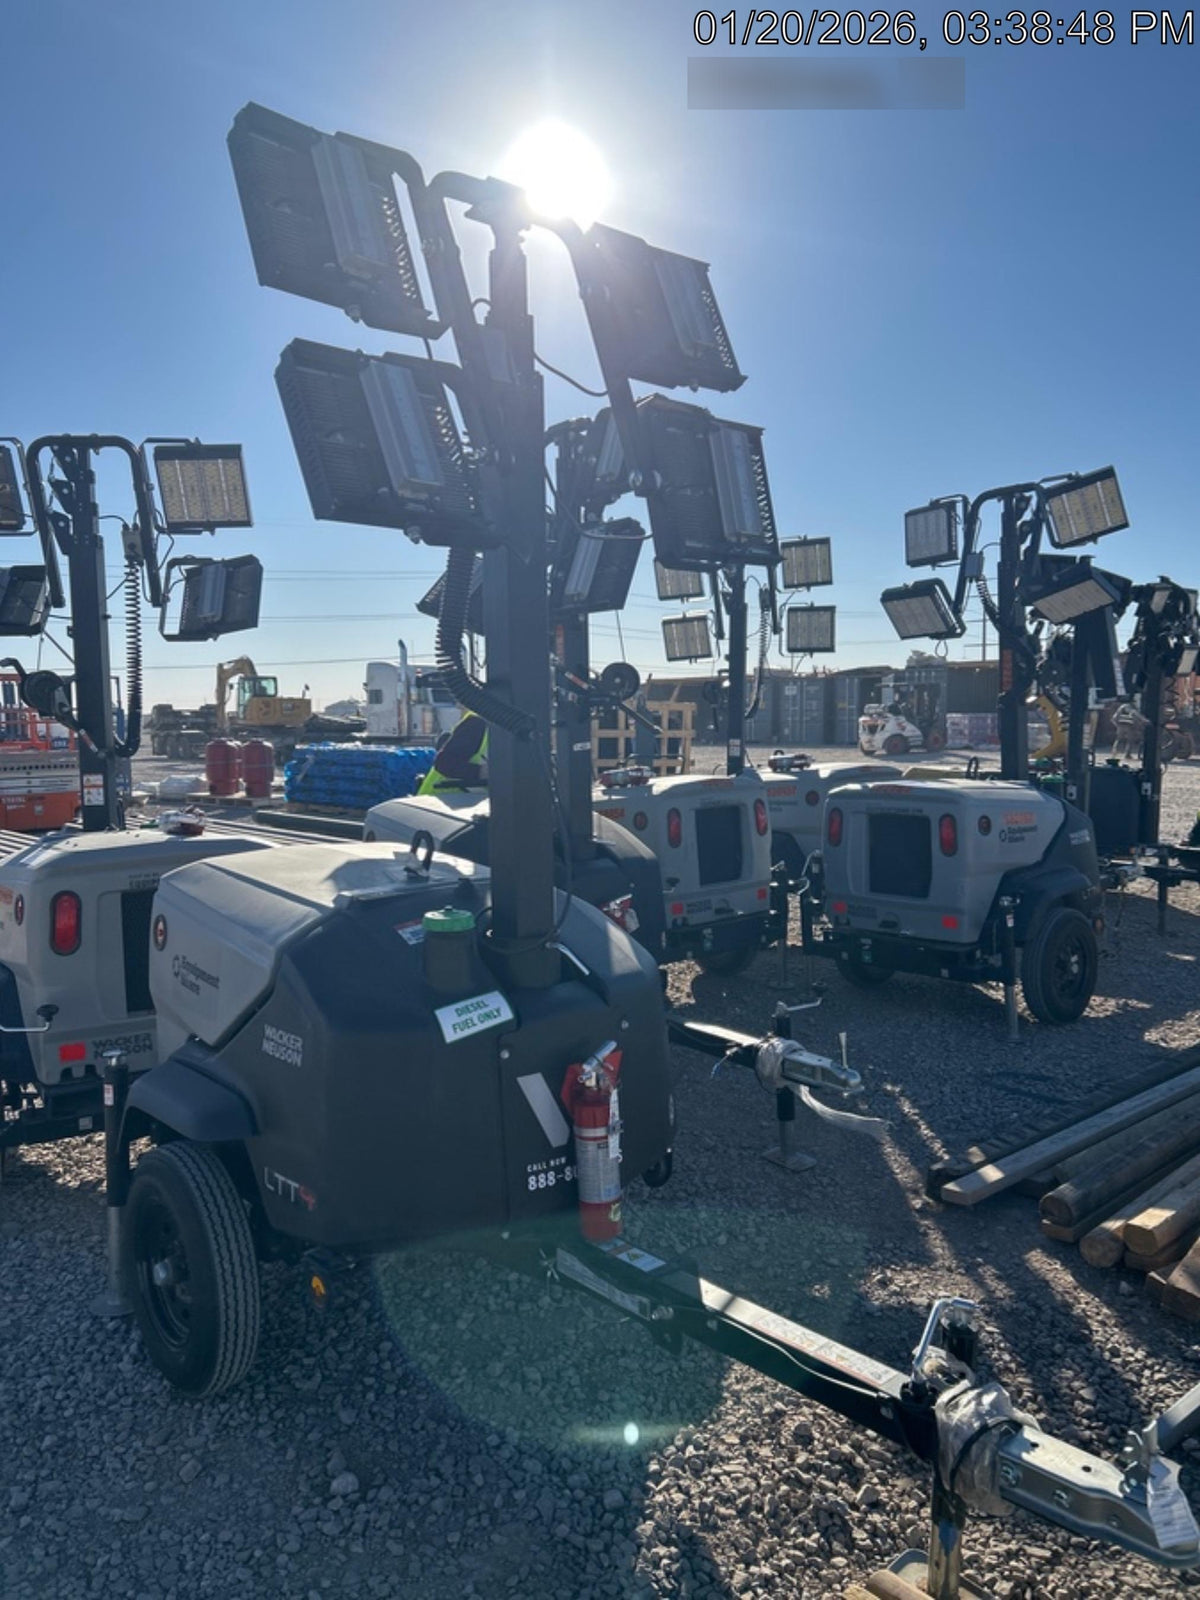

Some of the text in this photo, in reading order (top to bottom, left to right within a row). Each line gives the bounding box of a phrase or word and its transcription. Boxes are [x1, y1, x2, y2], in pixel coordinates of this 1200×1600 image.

[454, 1000, 489, 1018] DIESEL
[452, 1007, 502, 1034] FUEL ONLY
[92, 1032, 152, 1050] WACKER
[264, 1023, 303, 1048] WACKER
[261, 1038, 303, 1068] NEUSON
[527, 1160, 548, 1173] CALL
